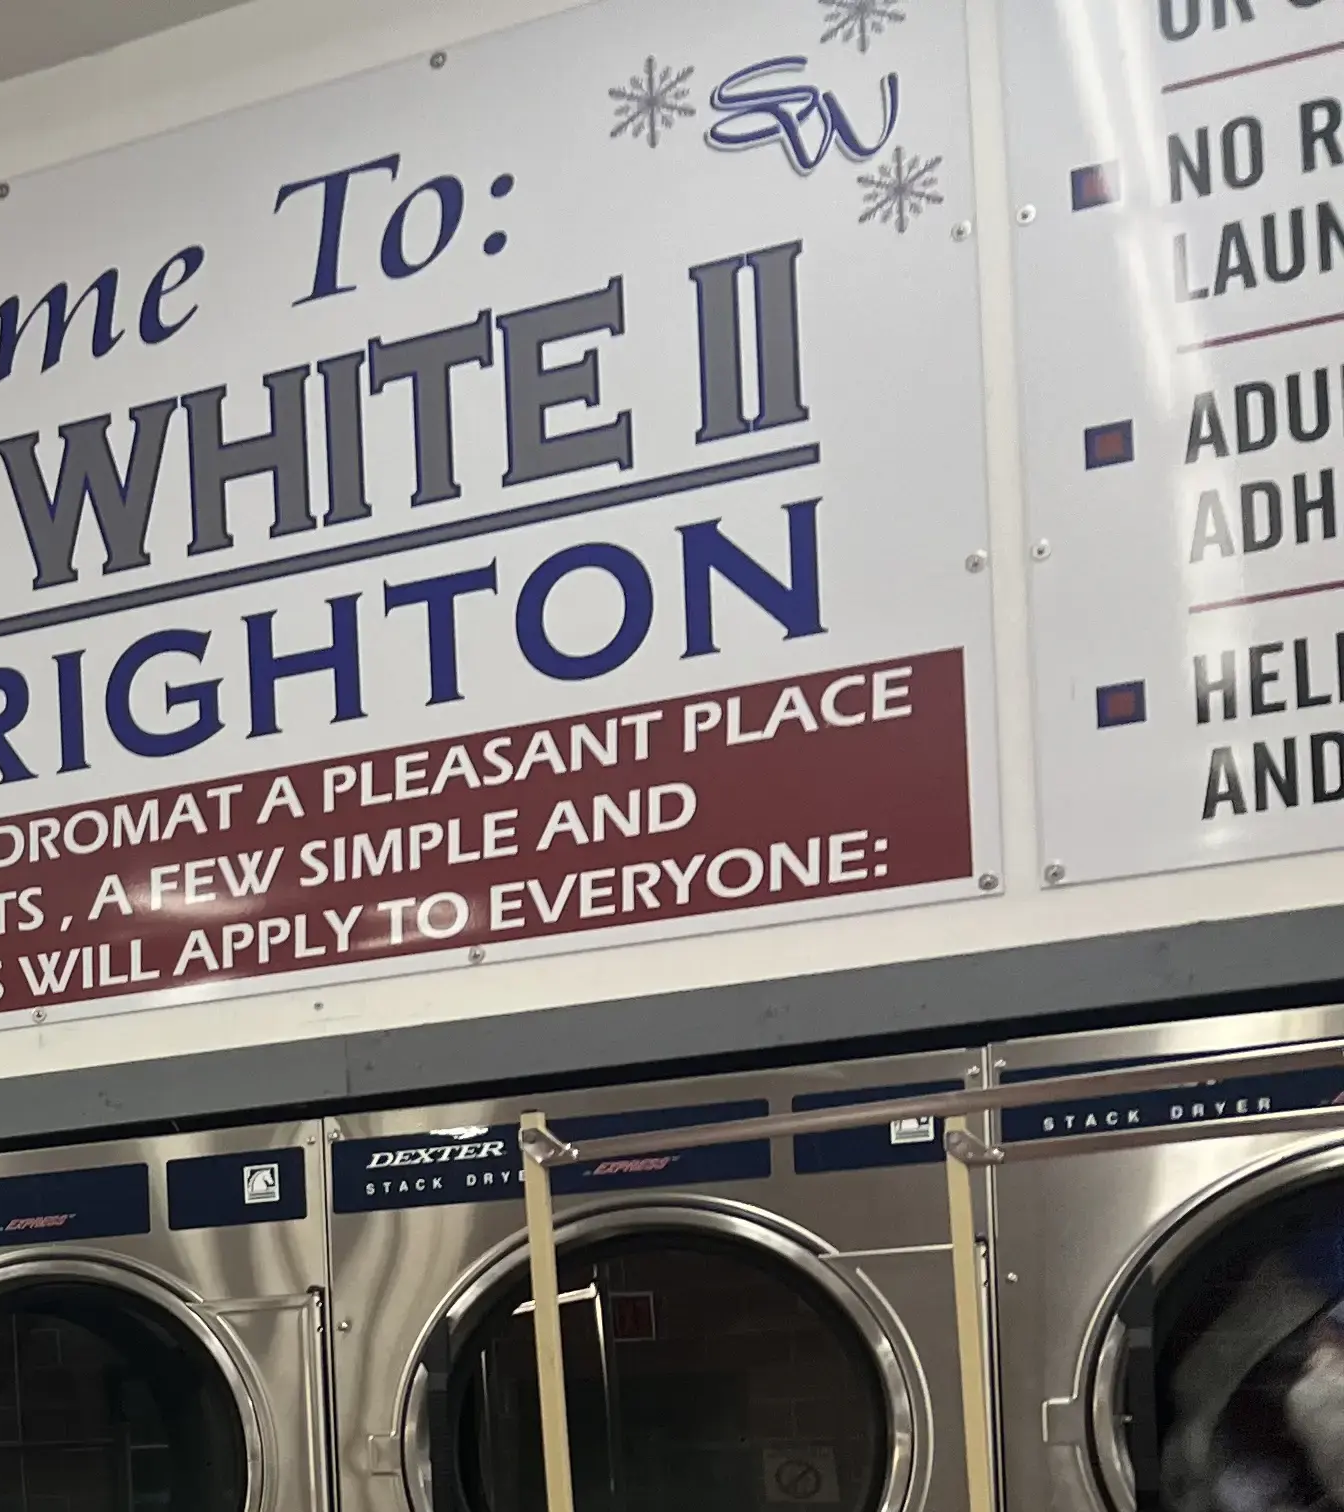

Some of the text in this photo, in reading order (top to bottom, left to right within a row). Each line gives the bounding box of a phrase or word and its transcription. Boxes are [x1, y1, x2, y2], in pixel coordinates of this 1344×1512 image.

[1168, 115, 1264, 204] NO
[272, 152, 515, 309] To:
[1173, 200, 1344, 303] LAUN
[689, 239, 811, 445] II
[1185, 364, 1344, 464] ADU
[1189, 467, 1336, 564] ADH
[1193, 631, 1344, 725] HEL
[257, 775, 305, 825] A
[323, 710, 663, 813] PLEASANT
[684, 665, 916, 753] PLACE
[1202, 730, 1344, 821] AND
[88, 873, 133, 921] A
[150, 848, 284, 911] FEW
[300, 809, 519, 887] SIMPLE
[536, 782, 697, 851] AND
[19, 939, 160, 996] WILL
[174, 904, 356, 976] APPLY
[378, 891, 471, 941] TO
[490, 831, 888, 931] EVERYONE:
[367, 1141, 504, 1169] DEXTER
[1043, 1097, 1272, 1132] STACK DRYER
[366, 1169, 527, 1196] STACK DRYE
